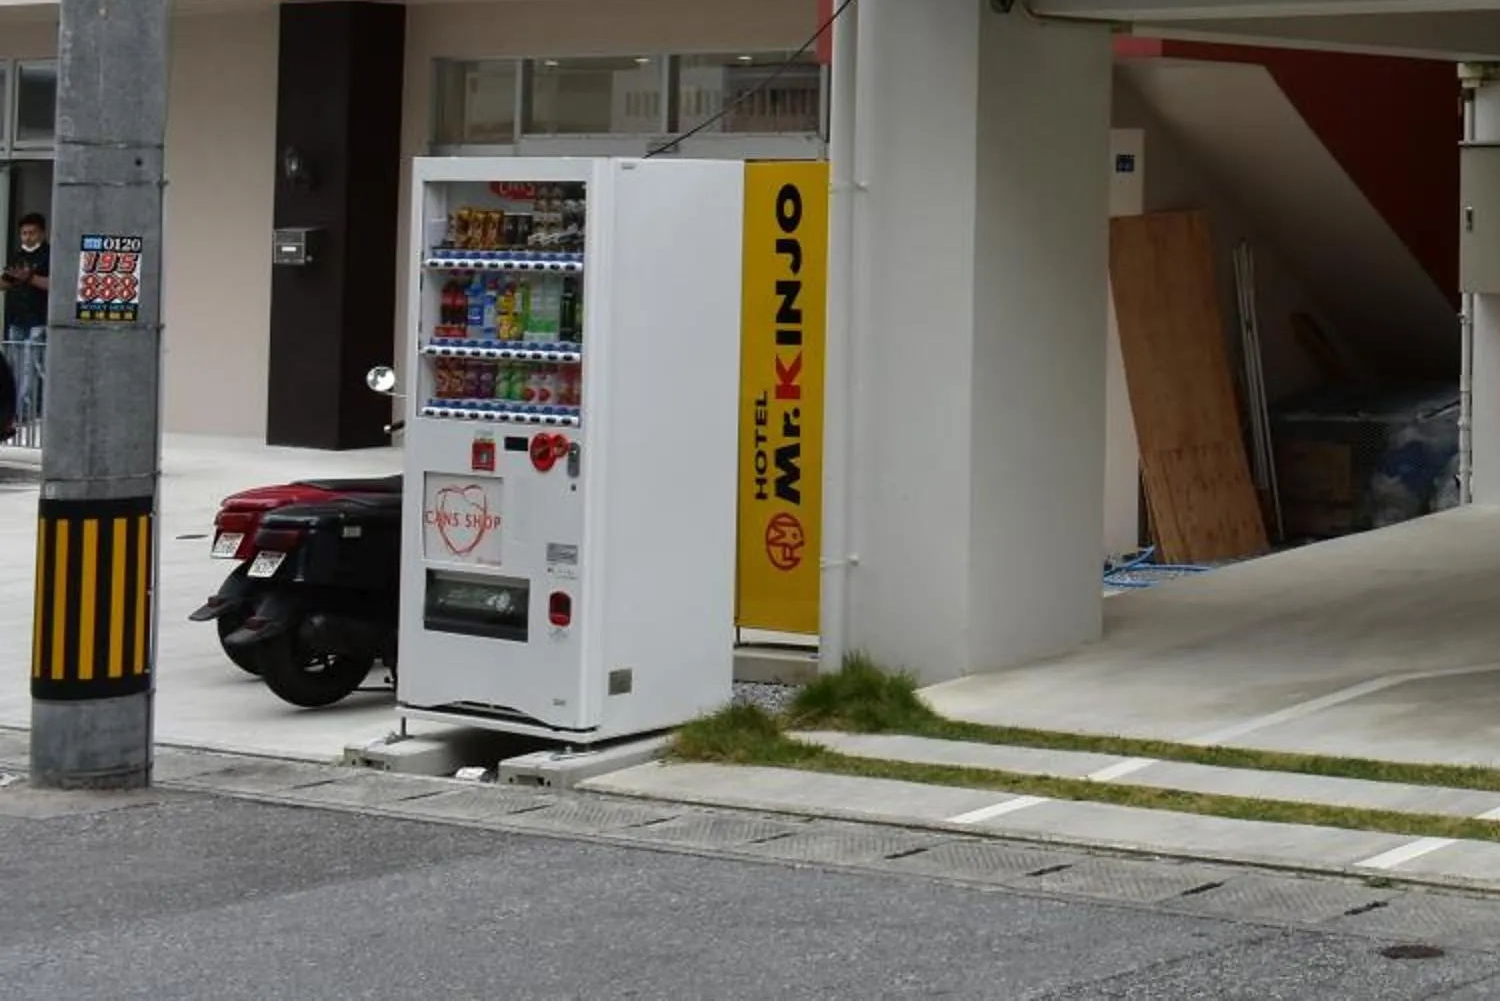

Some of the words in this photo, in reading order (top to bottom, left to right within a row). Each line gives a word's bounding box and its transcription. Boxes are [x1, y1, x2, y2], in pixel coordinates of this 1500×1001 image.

[103, 237, 141, 253] 0120
[80, 274, 138, 302] 888
[755, 390, 768, 500] HOTEL
[424, 510, 460, 529] CANS
[465, 512, 501, 529] SHOP
